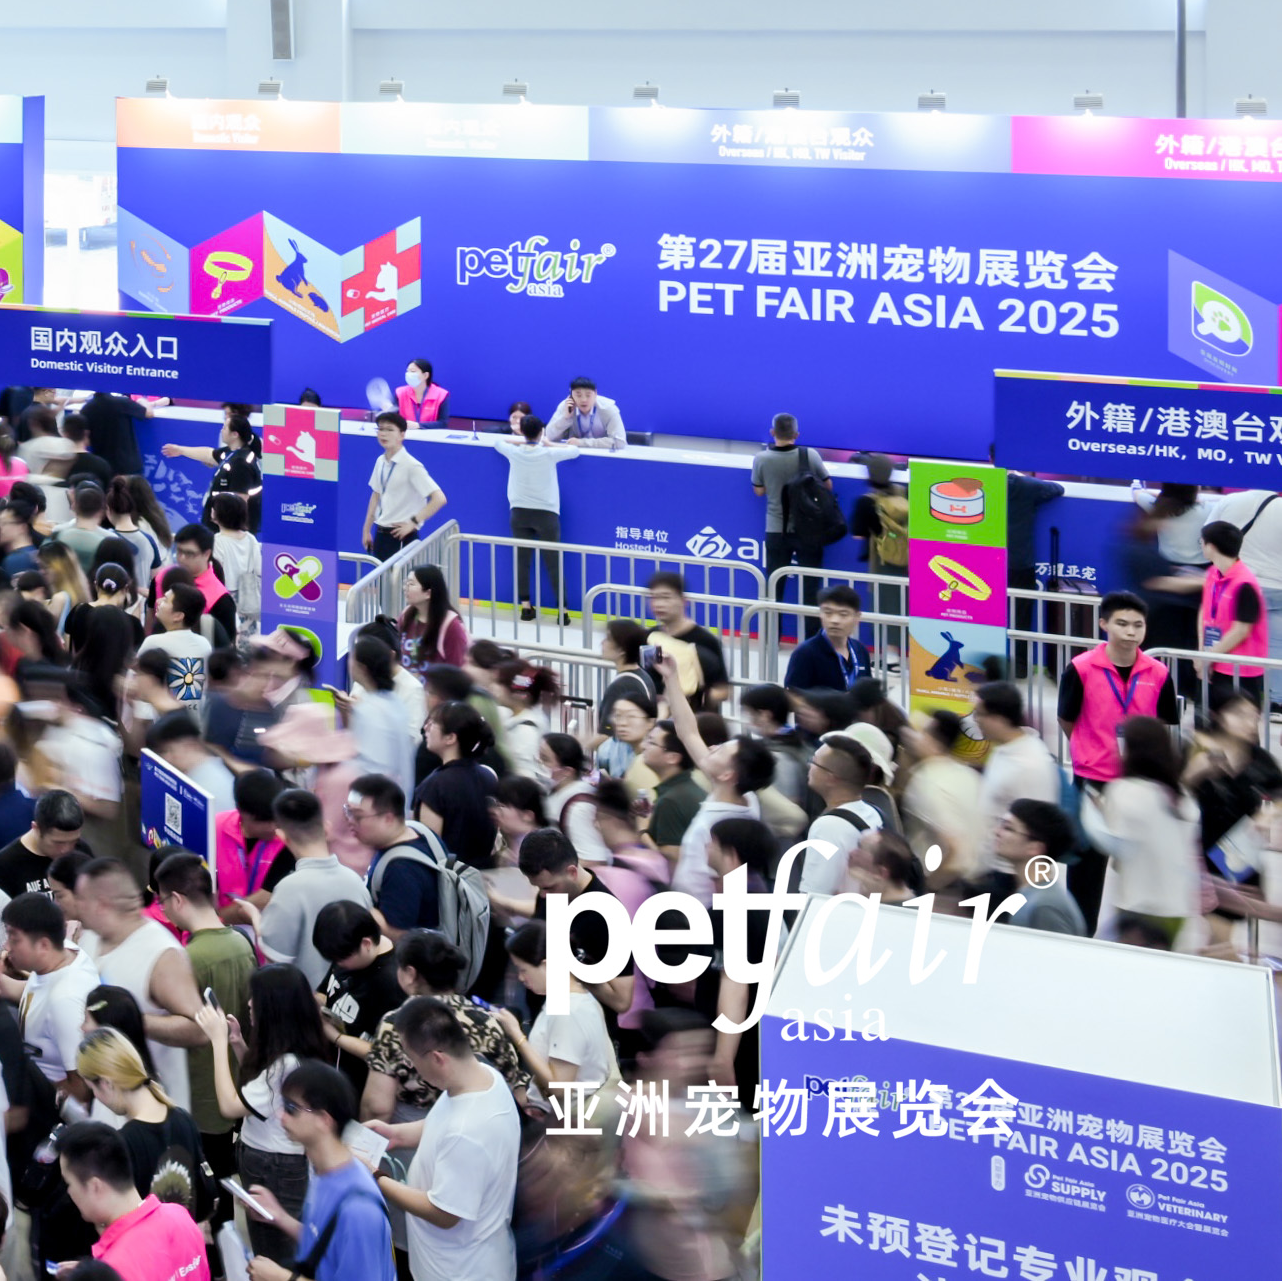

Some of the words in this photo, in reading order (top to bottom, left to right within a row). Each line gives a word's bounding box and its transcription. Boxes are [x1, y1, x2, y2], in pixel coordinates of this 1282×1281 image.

[657, 233, 1119, 293] 第27届亚洲宠物展览会
[527, 281, 564, 298] asia
[659, 280, 744, 316] PET
[756, 285, 855, 324] FAIR
[868, 291, 985, 331] ASIA
[998, 298, 1120, 338] 2025
[30, 326, 178, 361] 国内观众入口
[31, 358, 83, 372] Domestic
[86, 362, 123, 374] Visitor
[126, 365, 179, 379] Entrance
[1197, 447, 1234, 464] MO,
[1244, 451, 1272, 465] TW
[615, 526, 669, 543] 指导单位
[615, 542, 651, 553] Hosted
[992, 1127, 1059, 1160] FAIR
[1067, 1143, 1143, 1176] ASIA
[1151, 1158, 1229, 1193] 2025
[1052, 1174, 1063, 1182] Pet
[1064, 1176, 1078, 1185] Fair
[1079, 1179, 1095, 1188] Asia
[1052, 1181, 1107, 1202] SUPPLY
[1024, 1188, 1106, 1212] 亚洲宠物供应链展览会
[1158, 1193, 1170, 1201] Pet
[1171, 1196, 1186, 1205] Fair
[1188, 1199, 1205, 1208] Asia
[1127, 1209, 1229, 1237] 亚洲宠物医疗大会暨展览会
[1158, 1202, 1228, 1223] VETERINARY
[819, 1203, 1195, 1281] 未预登记专业
